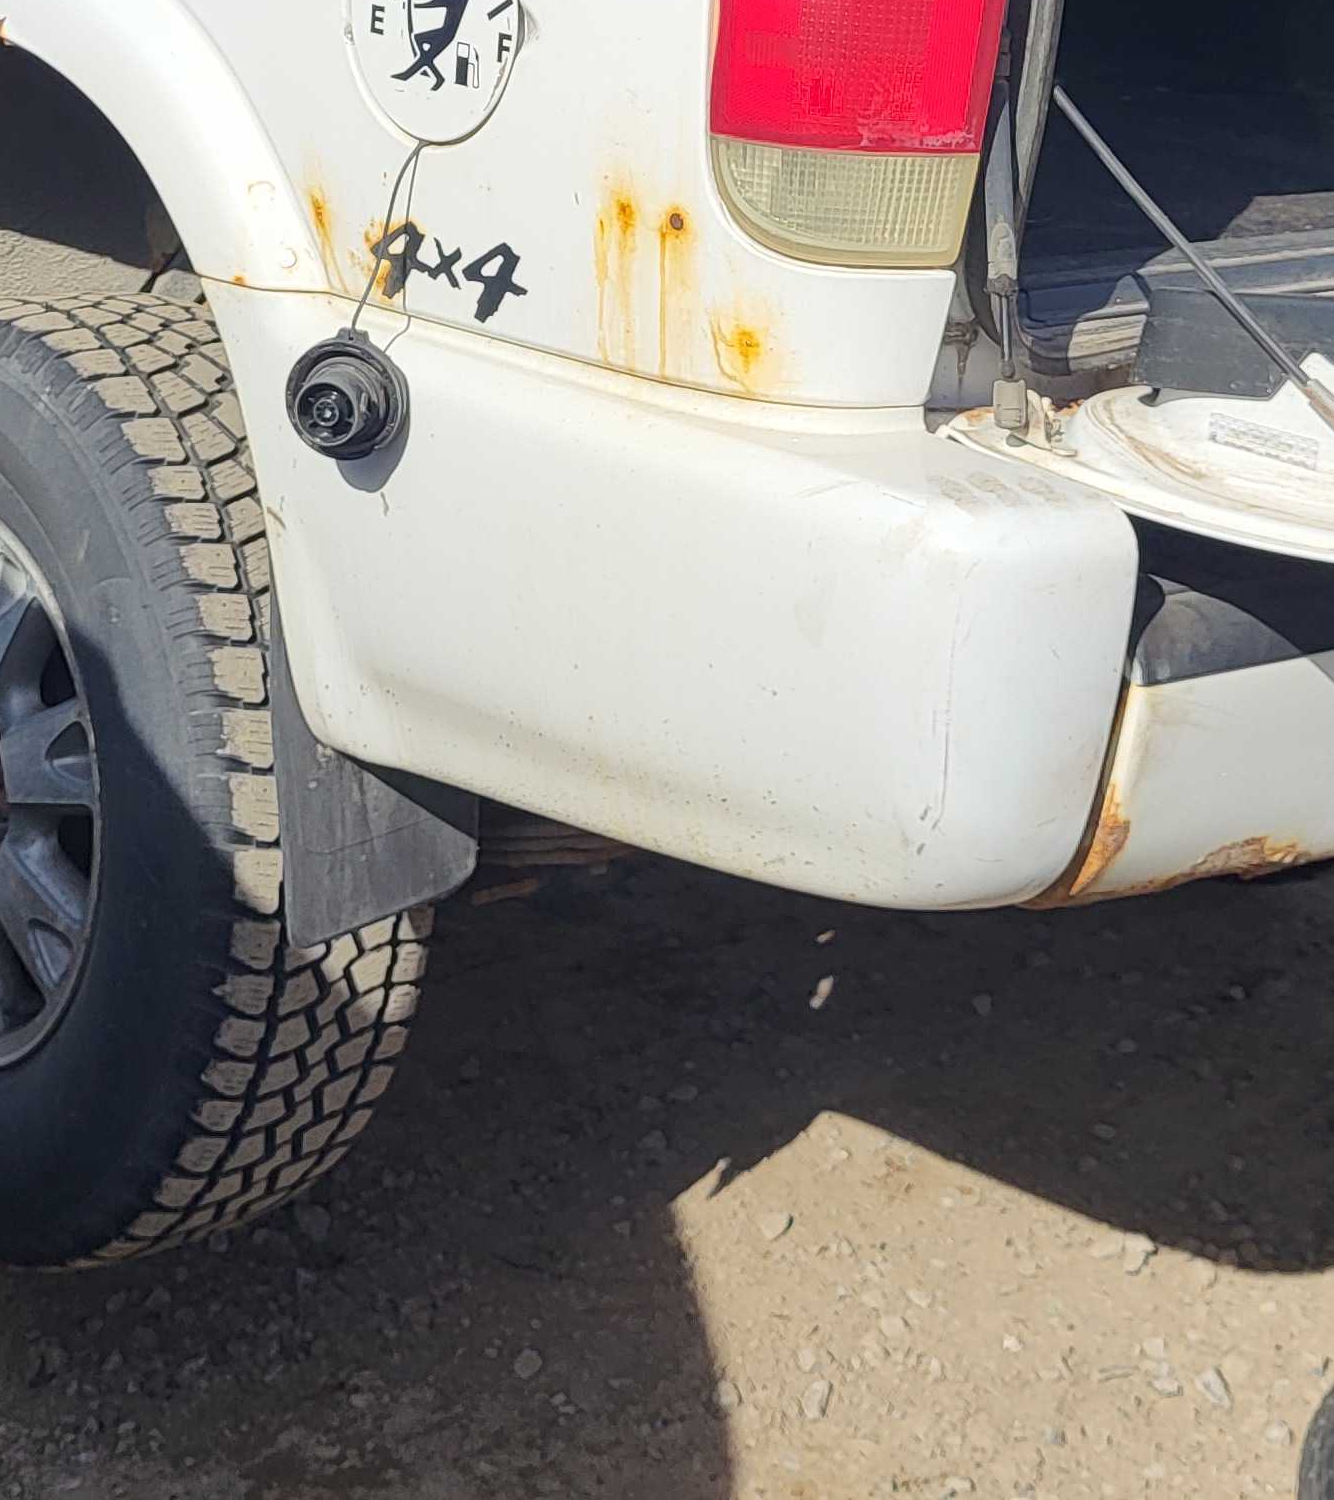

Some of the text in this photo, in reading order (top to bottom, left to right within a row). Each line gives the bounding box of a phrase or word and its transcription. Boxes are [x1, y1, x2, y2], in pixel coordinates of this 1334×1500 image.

[370, 4, 386, 36] E
[497, 32, 513, 63] F
[370, 221, 528, 324] 4x4
